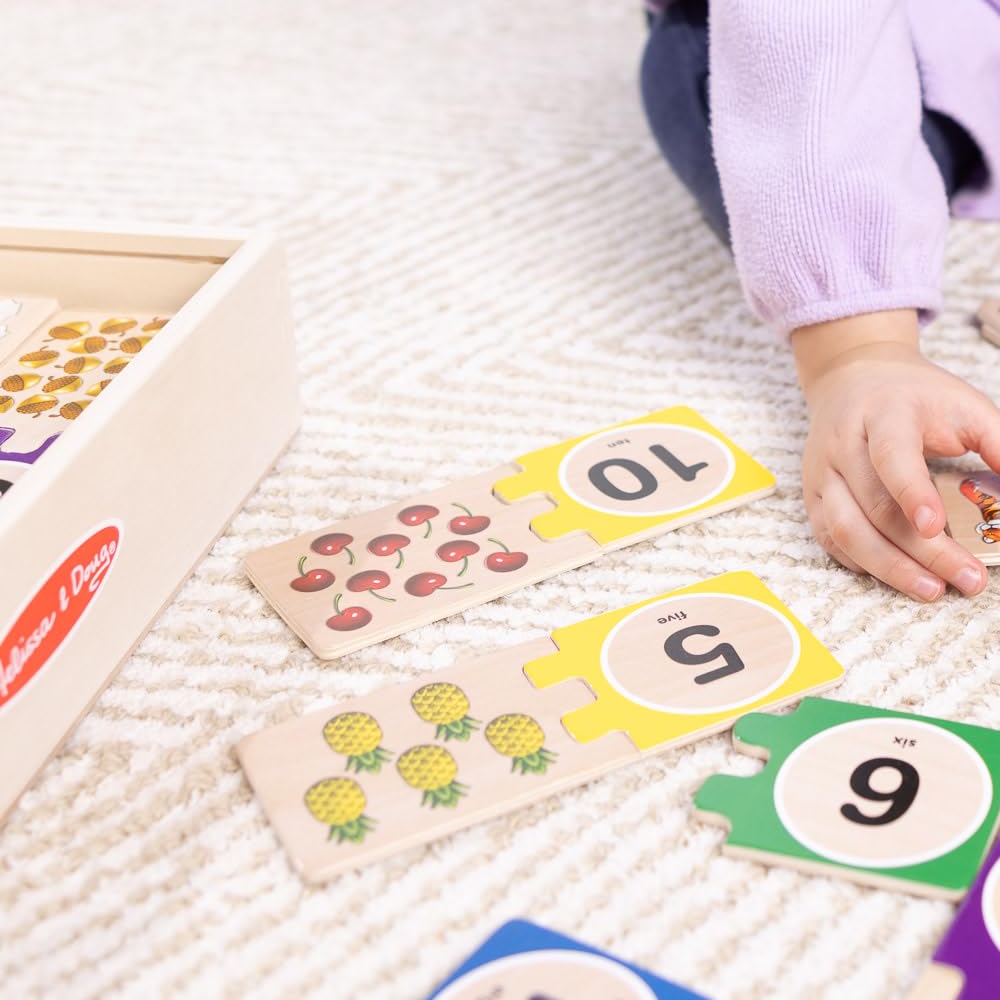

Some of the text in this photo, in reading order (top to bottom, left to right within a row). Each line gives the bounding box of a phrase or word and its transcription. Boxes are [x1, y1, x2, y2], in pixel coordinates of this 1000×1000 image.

[588, 444, 709, 500] 10
[657, 611, 688, 625] five
[664, 624, 745, 685] 5
[892, 735, 918, 749] six
[840, 757, 920, 826] 6
